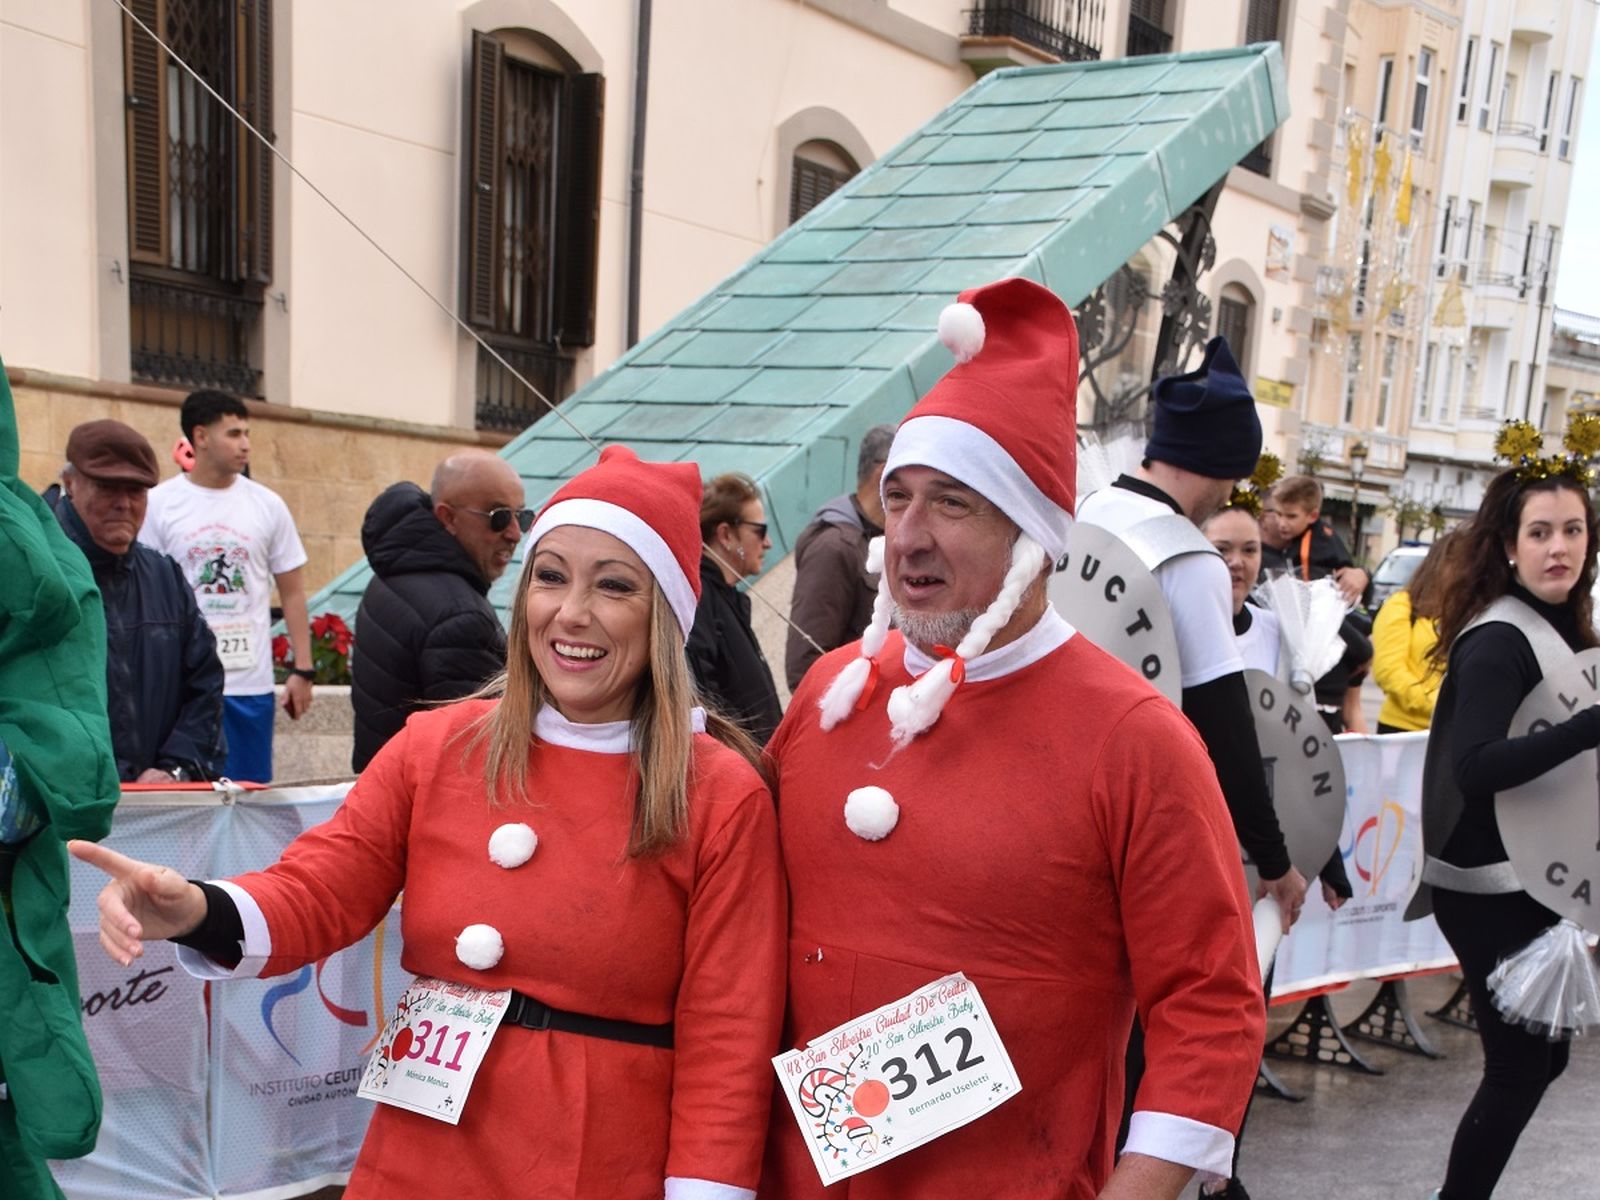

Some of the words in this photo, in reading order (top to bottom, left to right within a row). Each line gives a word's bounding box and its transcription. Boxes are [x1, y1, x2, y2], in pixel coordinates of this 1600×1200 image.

[1055, 552, 1161, 680] DUCTO
[221, 638, 250, 654] 271
[1259, 687, 1333, 797] ORÓN
[81, 966, 174, 1017] orte
[407, 1020, 471, 1072] 311
[805, 1049, 827, 1069] San
[830, 1028, 872, 1056] Silvestre
[876, 1003, 911, 1033] Ciudad
[915, 996, 936, 1016] De
[938, 981, 968, 1004] Ceuta
[886, 1032, 905, 1048] San
[908, 1015, 945, 1039] Silvestre
[948, 997, 974, 1020] Baby
[249, 1075, 322, 1097] INSTITUTO
[881, 1027, 985, 1101] 312
[288, 1094, 322, 1107] CIUDAD
[908, 1091, 952, 1116] Bernardo
[953, 1073, 990, 1097] Useletti
